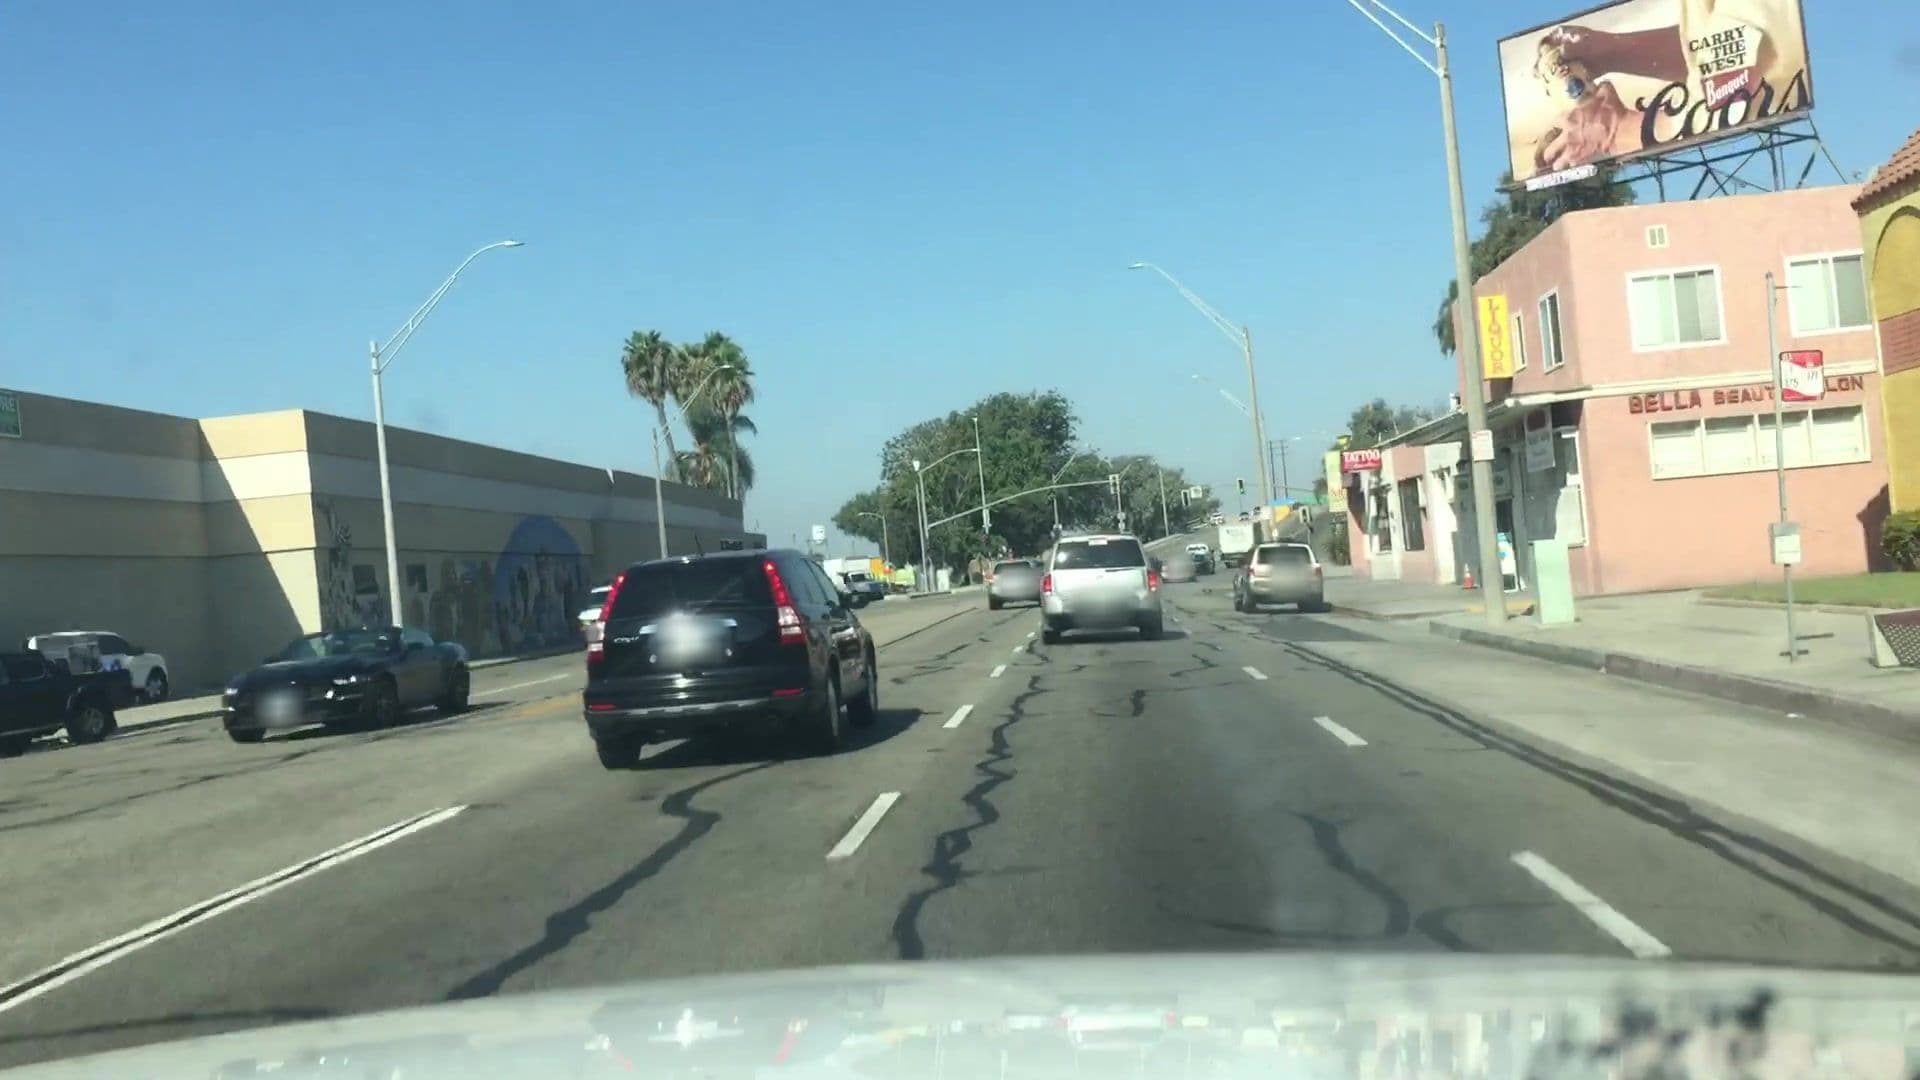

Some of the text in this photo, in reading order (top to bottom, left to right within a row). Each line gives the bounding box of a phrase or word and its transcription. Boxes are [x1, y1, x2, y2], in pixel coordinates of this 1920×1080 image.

[1689, 25, 1746, 52] CARRY
[1711, 40, 1746, 58] THE
[1699, 52, 1746, 75] WEST
[1705, 69, 1749, 106] Banquet
[1635, 69, 1809, 148] Coors
[1488, 298, 1504, 374] LIQUOR
[1629, 376, 1863, 414] BELLA BEAUT LON
[1342, 449, 1380, 463] TATTOO
